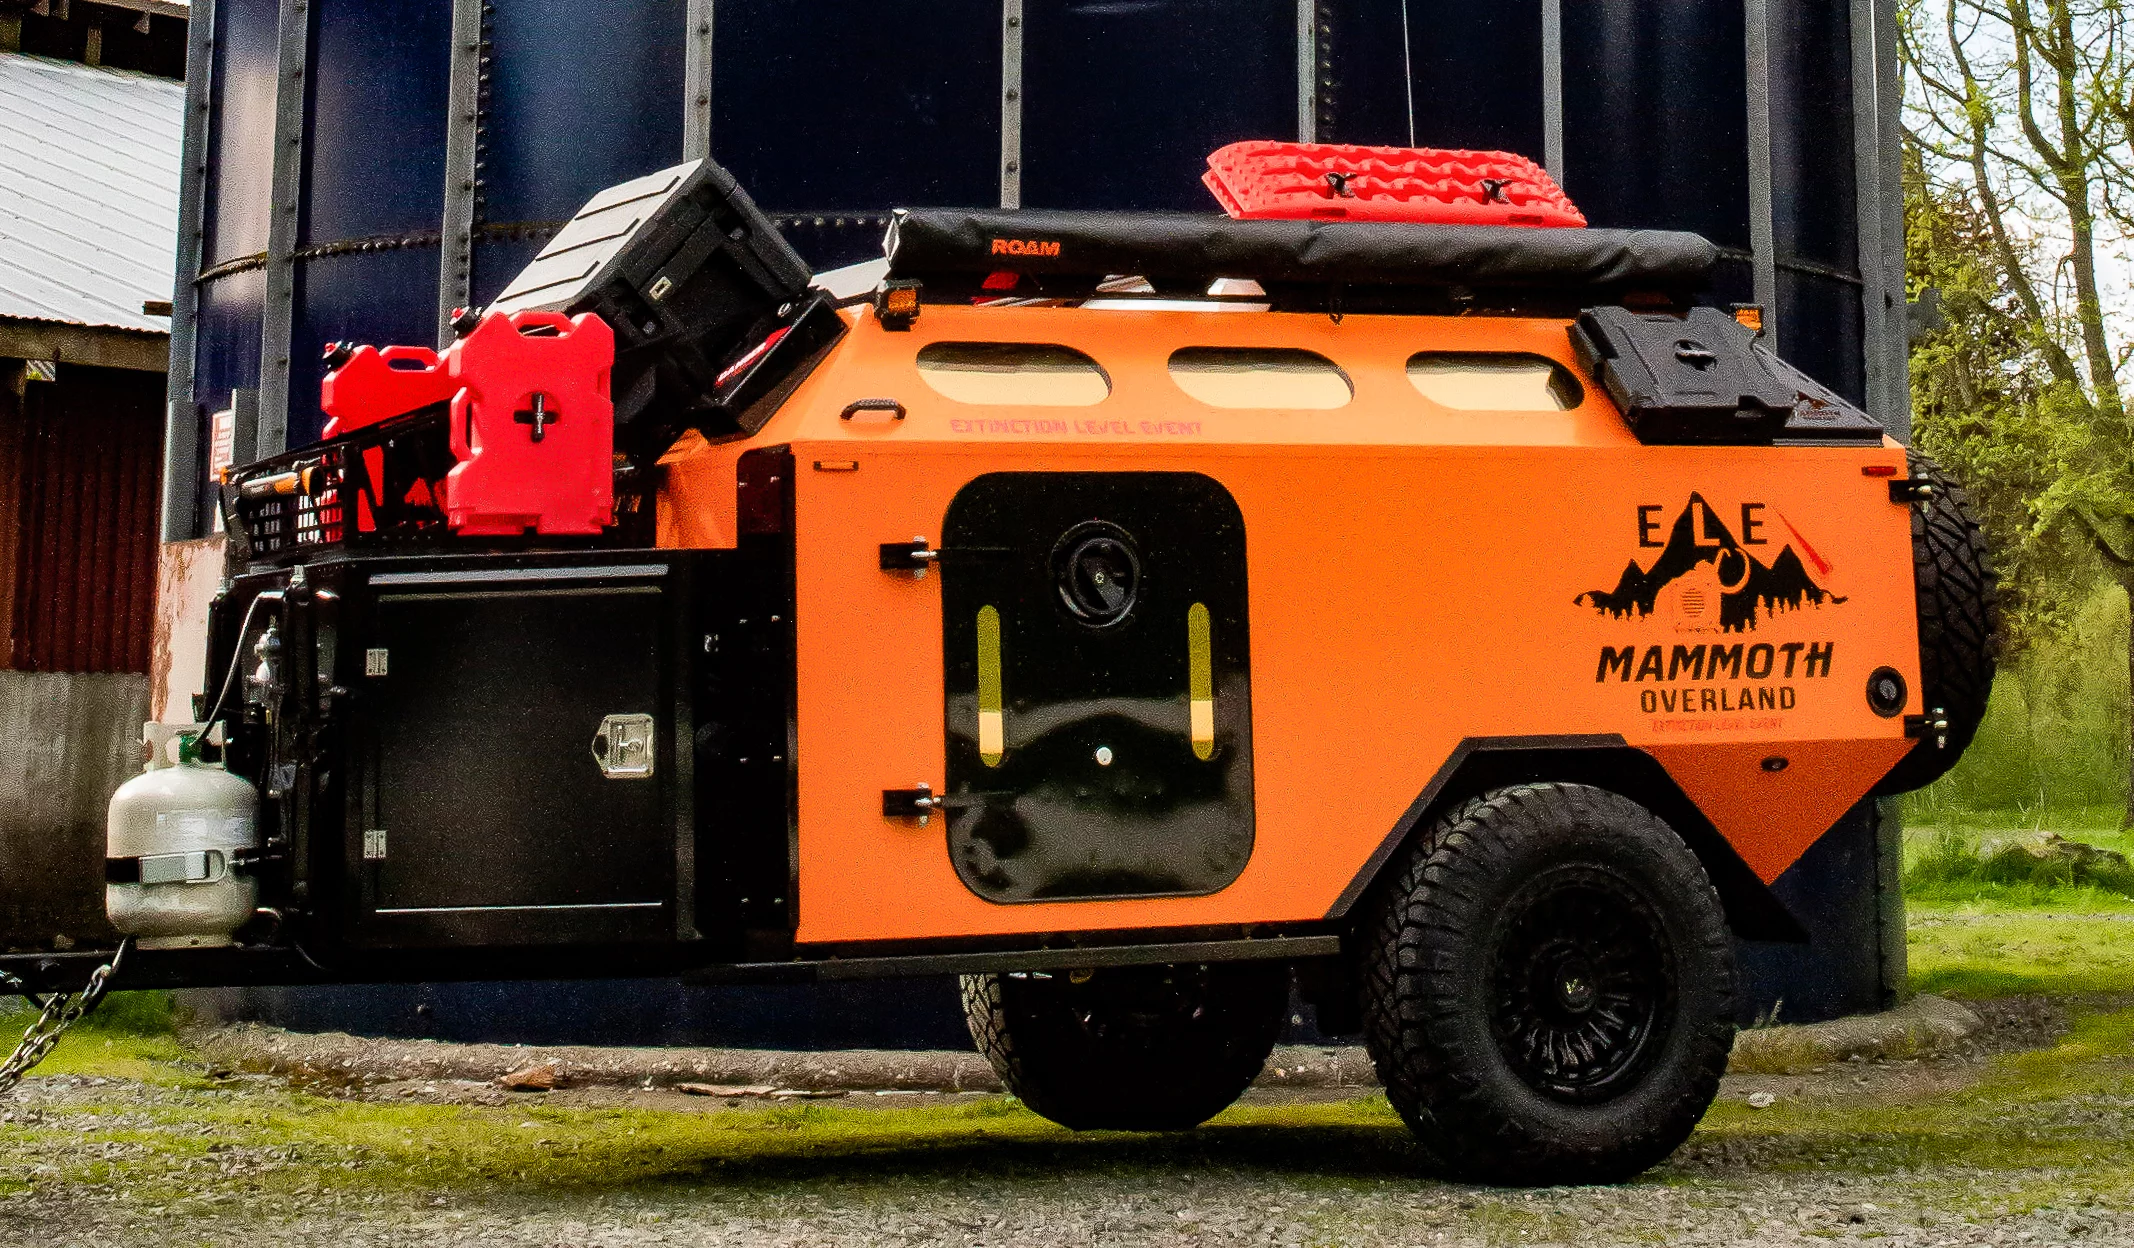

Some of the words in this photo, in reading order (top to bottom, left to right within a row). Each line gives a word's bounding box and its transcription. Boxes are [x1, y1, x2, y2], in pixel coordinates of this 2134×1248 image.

[992, 239, 1061, 256] ROAM
[950, 419, 1068, 434] EXTINCTION
[1074, 420, 1136, 434] LEVEL
[1141, 421, 1202, 435] EVENT
[1595, 642, 1834, 683] MAMMOTH
[1640, 686, 1796, 713] OVERLAND
